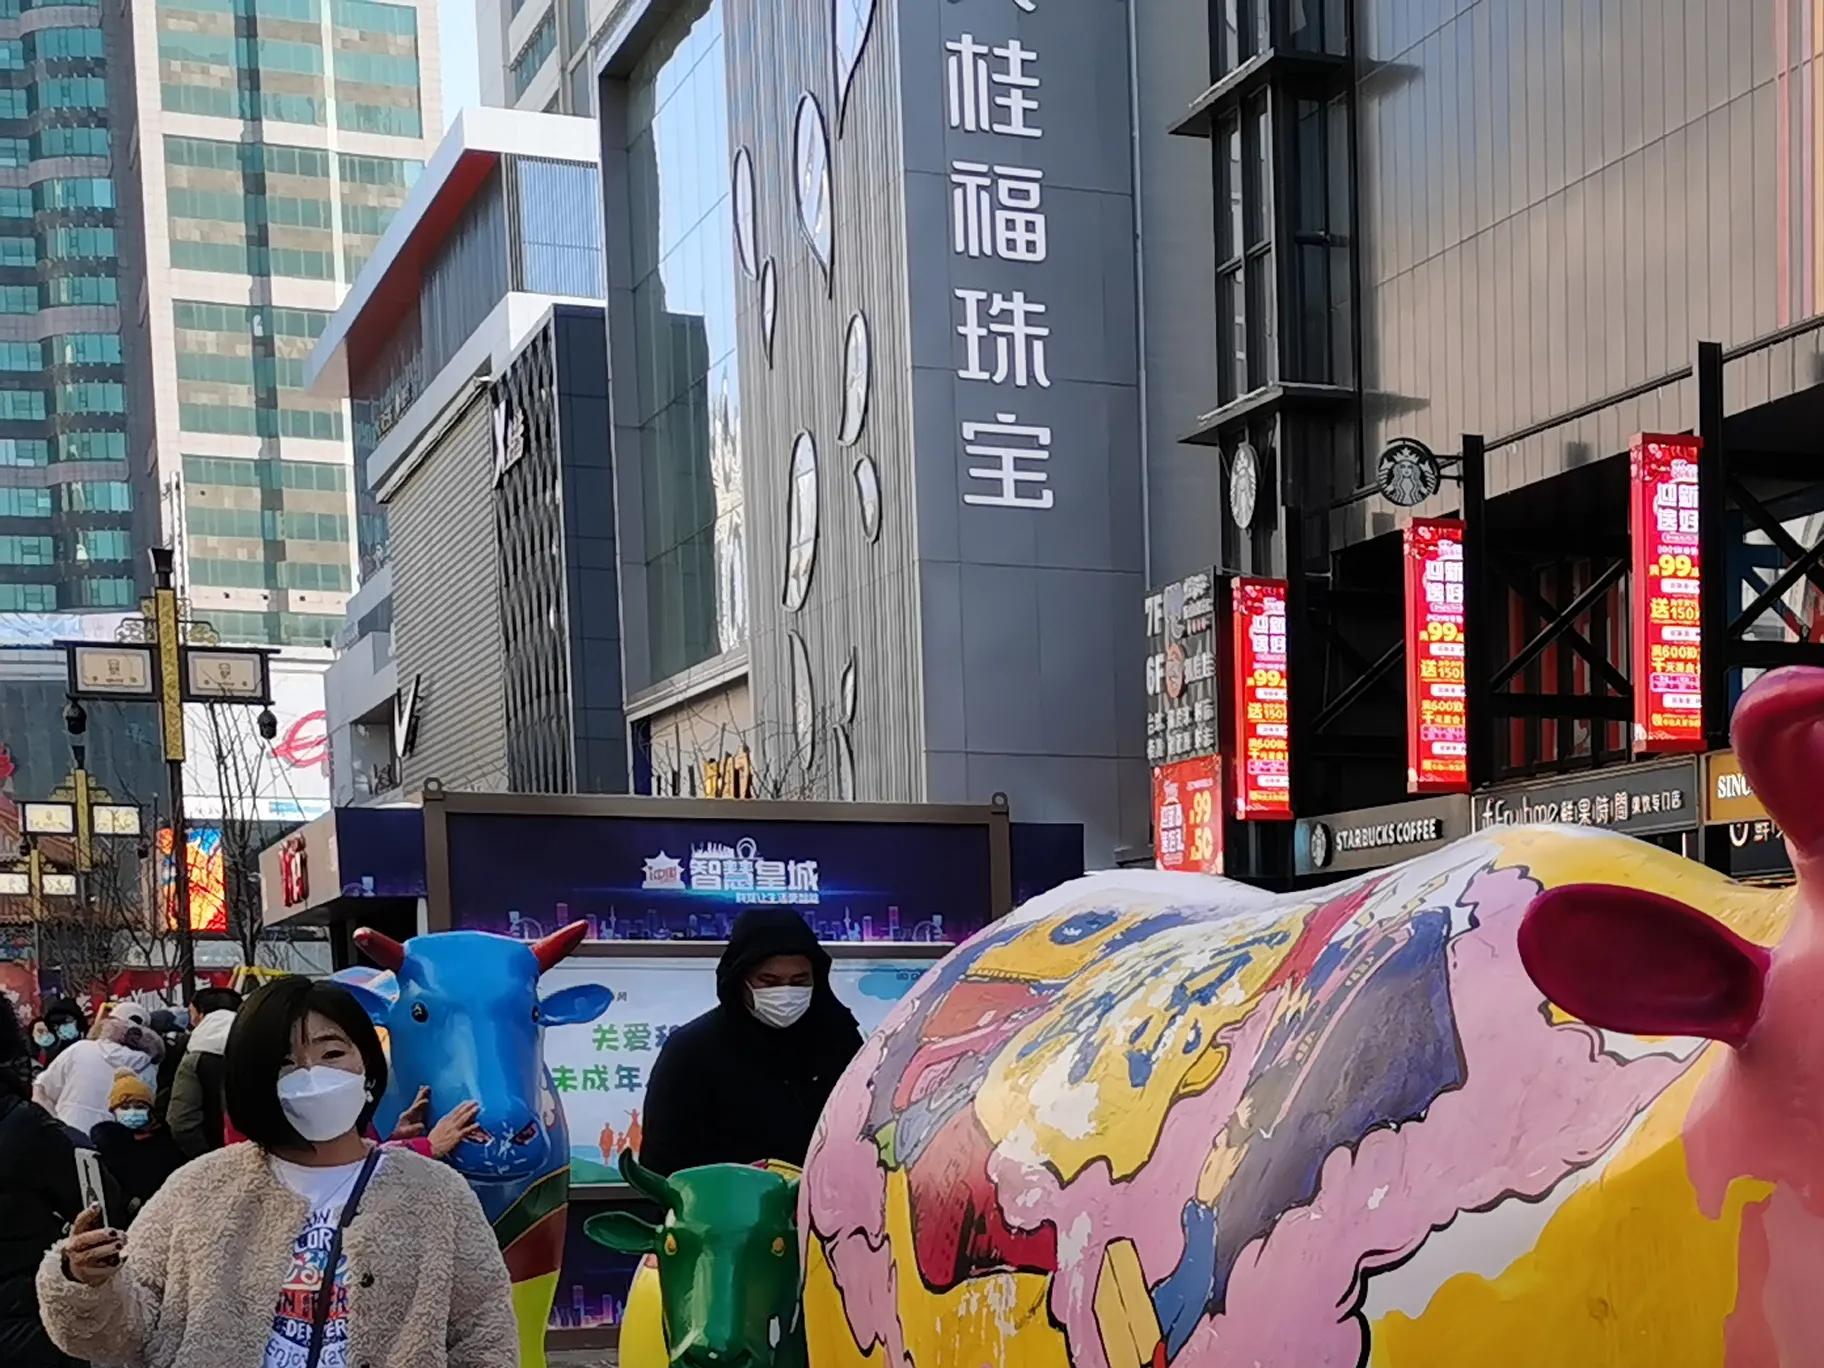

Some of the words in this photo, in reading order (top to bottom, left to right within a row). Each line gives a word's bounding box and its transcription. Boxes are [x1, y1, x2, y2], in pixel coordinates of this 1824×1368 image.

[944, 0, 1056, 511] 桂福珠宝
[1336, 823, 1395, 851] STARBUCKS
[1396, 818, 1438, 844] COFFEE
[690, 858, 819, 891] 智慧皇城
[551, 1064, 649, 1092] 未成年
